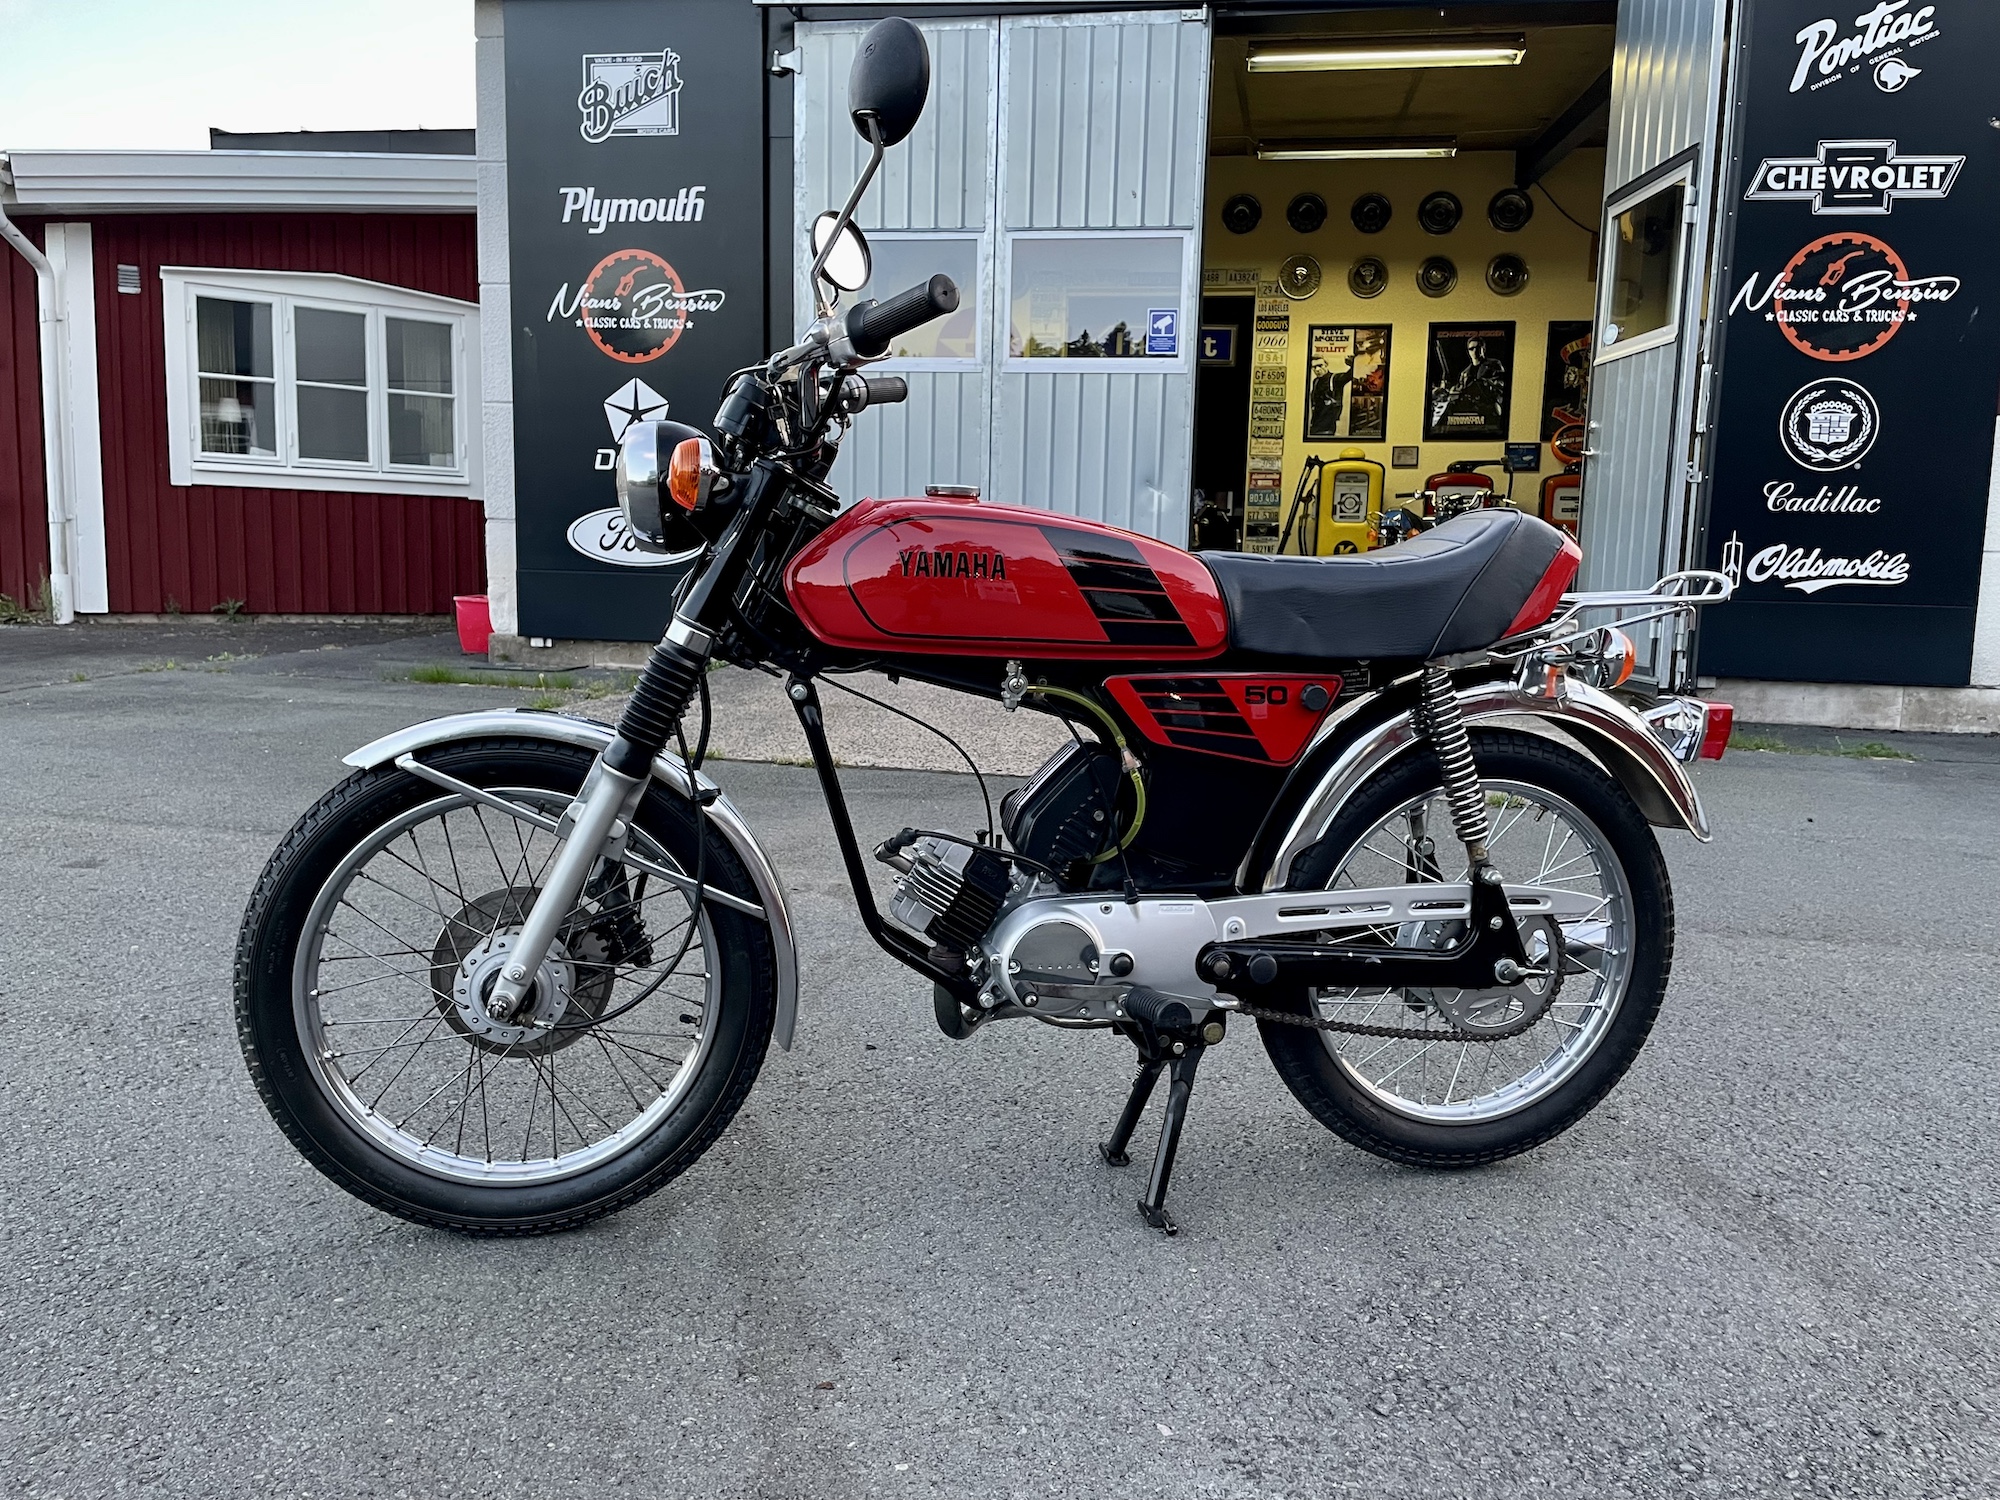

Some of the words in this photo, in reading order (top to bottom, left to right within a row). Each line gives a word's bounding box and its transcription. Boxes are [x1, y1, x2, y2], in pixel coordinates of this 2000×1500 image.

[1789, 0, 1935, 92] Pontiac
[1810, 73, 1842, 91] DIVISION
[1850, 64, 1860, 73] OF
[1868, 47, 1903, 65] GENERAL
[1908, 29, 1940, 48] MOTORS
[578, 47, 684, 144] Buick
[1766, 166, 1945, 190] CHEVROLET
[558, 185, 706, 234] Plymouth
[631, 283, 726, 320] Bensin
[1839, 270, 1961, 312] Bensin
[583, 317, 618, 329] CLASSIC
[619, 317, 641, 329] CARS
[643, 318, 652, 329] &
[652, 318, 685, 330] TRUCKS
[1258, 304, 1267, 313] LOS
[1268, 304, 1289, 313] ANGELES
[1776, 310, 1819, 322] CLASSIC
[1822, 310, 1850, 322] CARS
[1853, 311, 1863, 322] &
[1865, 310, 1905, 323] TRUCKS
[1256, 320, 1289, 330] GOODGUYS
[1258, 334, 1286, 348] 1966
[1763, 481, 1881, 513] Cadillac
[899, 550, 1008, 580] YAMAHA
[1746, 543, 1911, 586] Oldsmobile
[1244, 685, 1288, 706] 50
